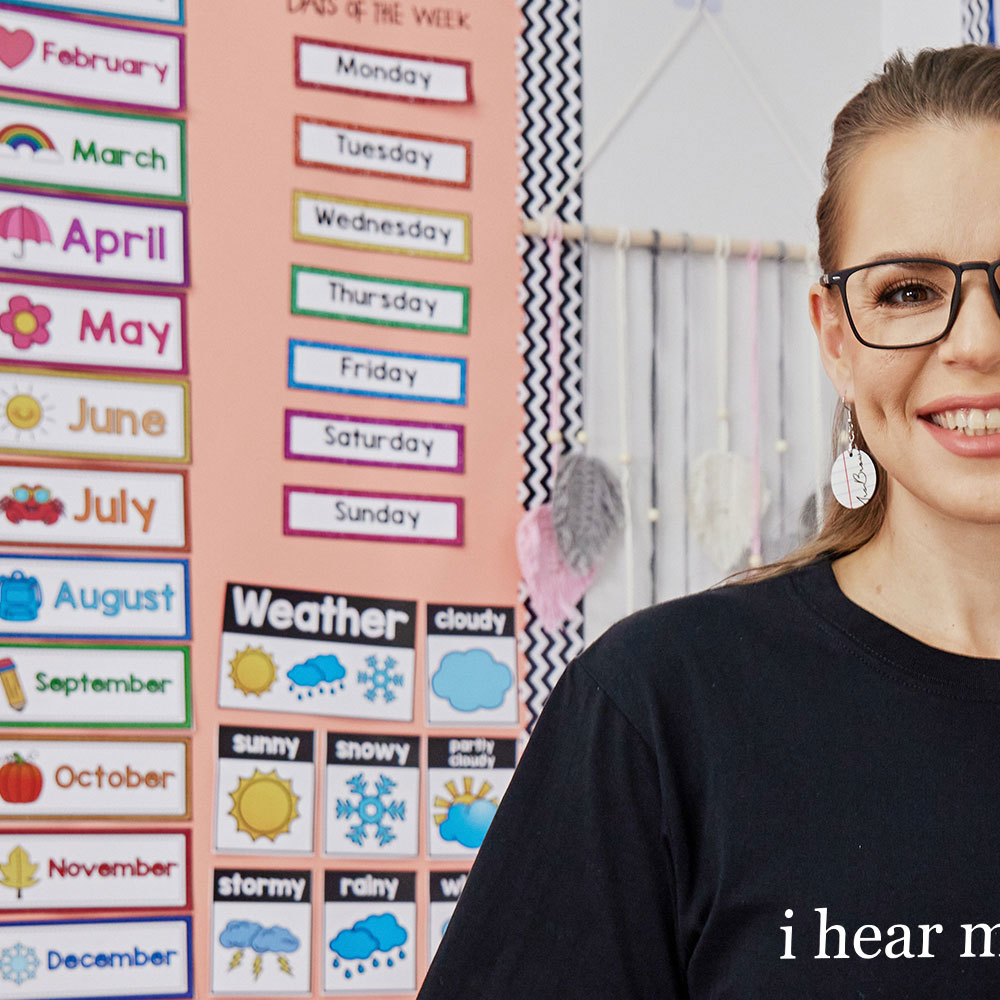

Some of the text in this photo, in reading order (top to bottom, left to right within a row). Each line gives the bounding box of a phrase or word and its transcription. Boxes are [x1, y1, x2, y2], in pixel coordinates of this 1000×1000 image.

[373, 2, 402, 25] THE
[412, 5, 471, 30] WEEK
[43, 40, 168, 83] February
[336, 55, 432, 90] Monday
[73, 139, 166, 170] March
[336, 135, 433, 170] Tuesday
[62, 218, 166, 263] April
[315, 206, 452, 245] Wednesday
[328, 281, 438, 315] Thursday
[79, 309, 170, 355] May
[340, 357, 418, 387] Friday
[69, 397, 166, 437] June
[324, 425, 435, 457] Saturday
[74, 488, 156, 533] July
[335, 501, 421, 528] Sunday
[54, 581, 174, 616] August
[233, 585, 409, 641] Weather
[434, 608, 506, 634] cloudy
[36, 673, 172, 697] September
[232, 732, 300, 760] sunny
[335, 740, 409, 764] snowy
[448, 736, 495, 754] partly
[448, 751, 497, 769] cloudy
[55, 765, 174, 789] October
[49, 859, 177, 878] November
[218, 874, 306, 900] stormy
[339, 874, 400, 901] rainy
[780, 909, 796, 959] i
[814, 908, 943, 959] hear
[48, 948, 176, 970] December
